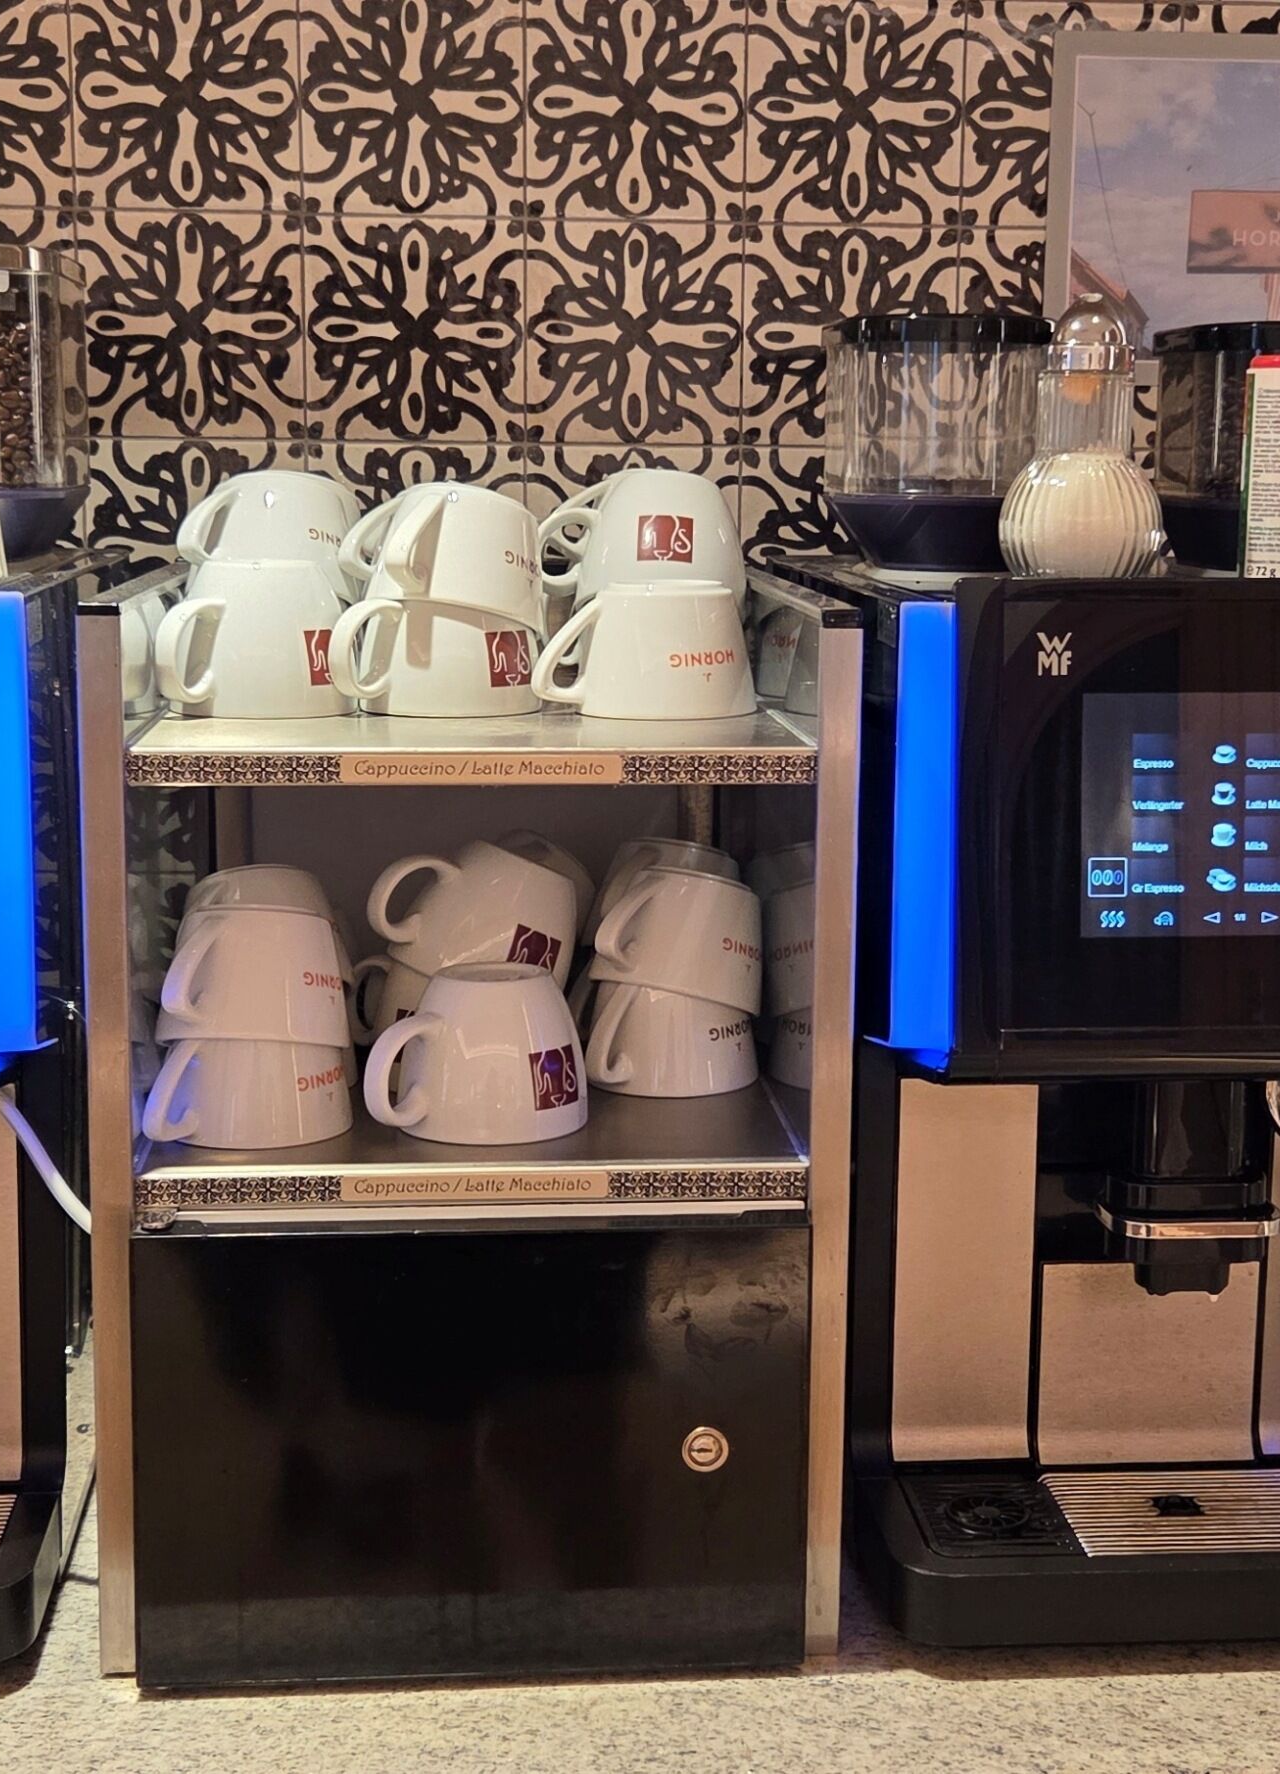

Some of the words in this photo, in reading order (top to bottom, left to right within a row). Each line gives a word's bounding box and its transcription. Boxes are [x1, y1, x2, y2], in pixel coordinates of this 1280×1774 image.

[308, 528, 342, 549] RNIG
[1255, 566, 1268, 576] 72
[669, 650, 735, 668] HORNIG
[354, 760, 456, 779] Cappuccino
[471, 761, 514, 776] Latte
[518, 760, 605, 776] Macchiato
[1133, 759, 1174, 770] Espresso
[354, 1178, 449, 1196] Cappuccino
[465, 1178, 505, 1193] Latte
[508, 1177, 591, 1191] Macchiato
